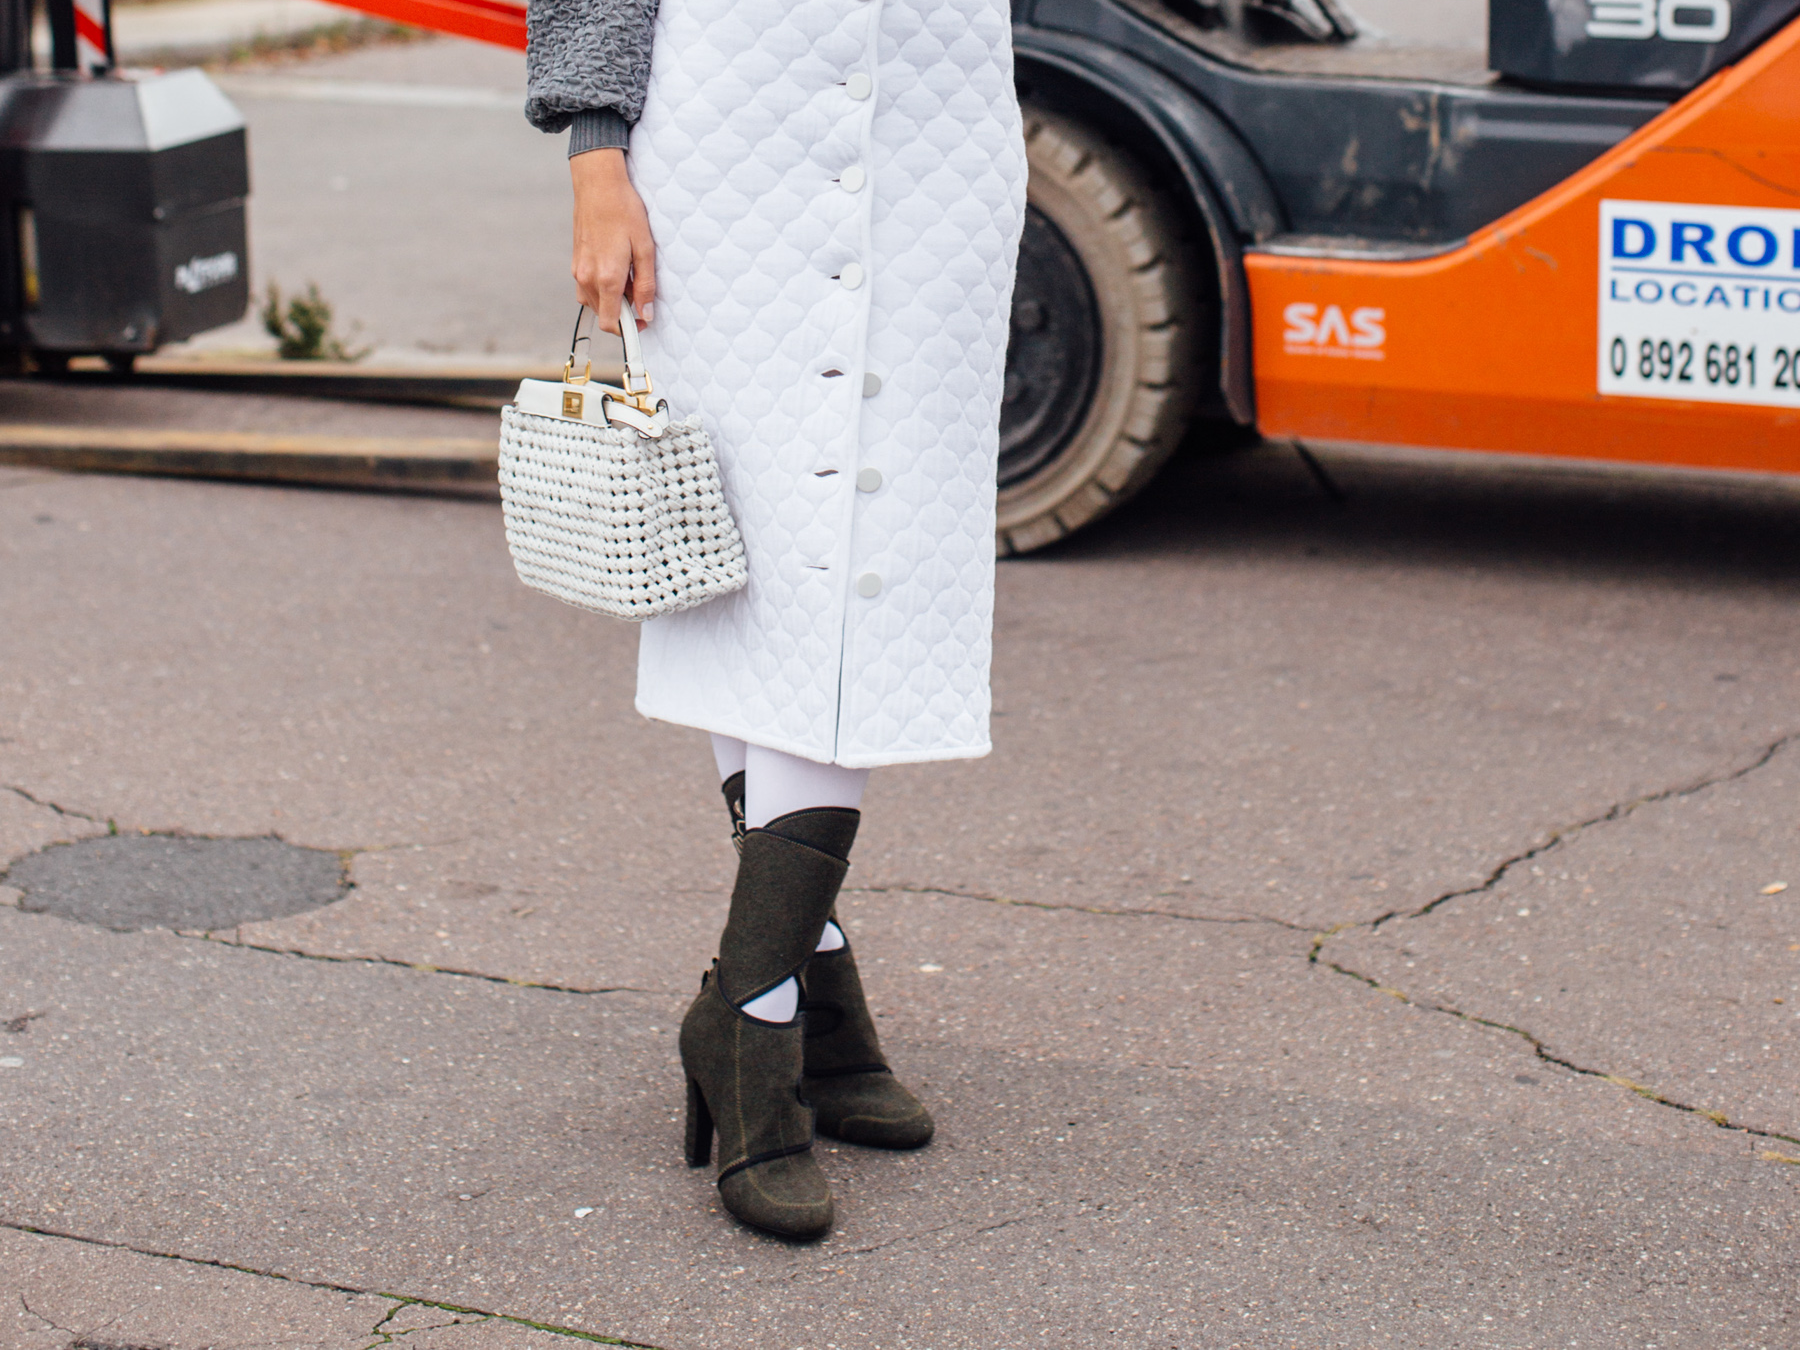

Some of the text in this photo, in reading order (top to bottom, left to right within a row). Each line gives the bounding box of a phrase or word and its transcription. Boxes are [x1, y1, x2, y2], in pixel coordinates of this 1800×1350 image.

[1612, 218, 1800, 269] DRO
[1283, 302, 1386, 348] SAS
[1611, 337, 1627, 378] 0
[1639, 338, 1693, 382] 892
[1705, 344, 1758, 387] 681
